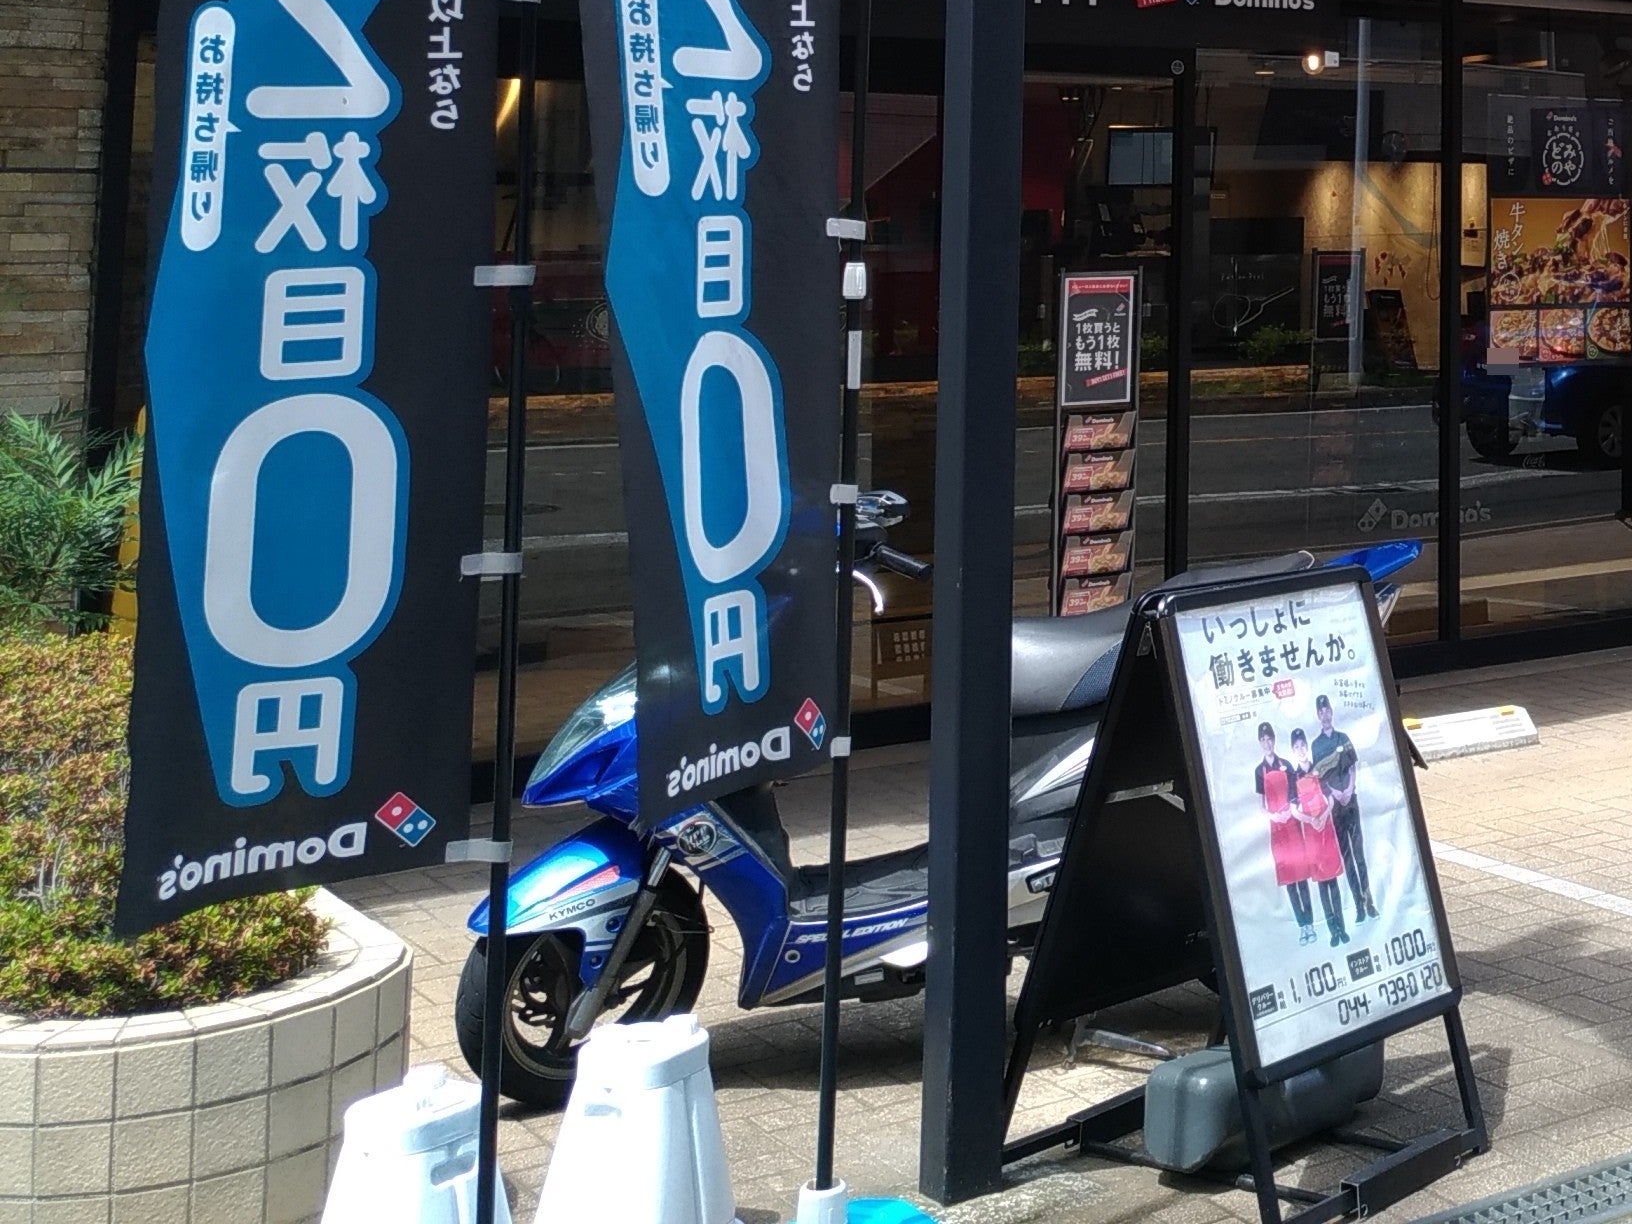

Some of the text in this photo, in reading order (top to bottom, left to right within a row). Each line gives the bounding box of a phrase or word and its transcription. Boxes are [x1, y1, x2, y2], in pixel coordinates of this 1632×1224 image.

[1075, 322, 1121, 334] 1枚買うと
[1075, 334, 1120, 351] もう1枚
[1074, 350, 1120, 372] 無料!
[1391, 500, 1492, 530] Domo's
[1202, 599, 1311, 644] いっしょに
[548, 898, 596, 921] KYMCO
[850, 917, 909, 937] EDITION
